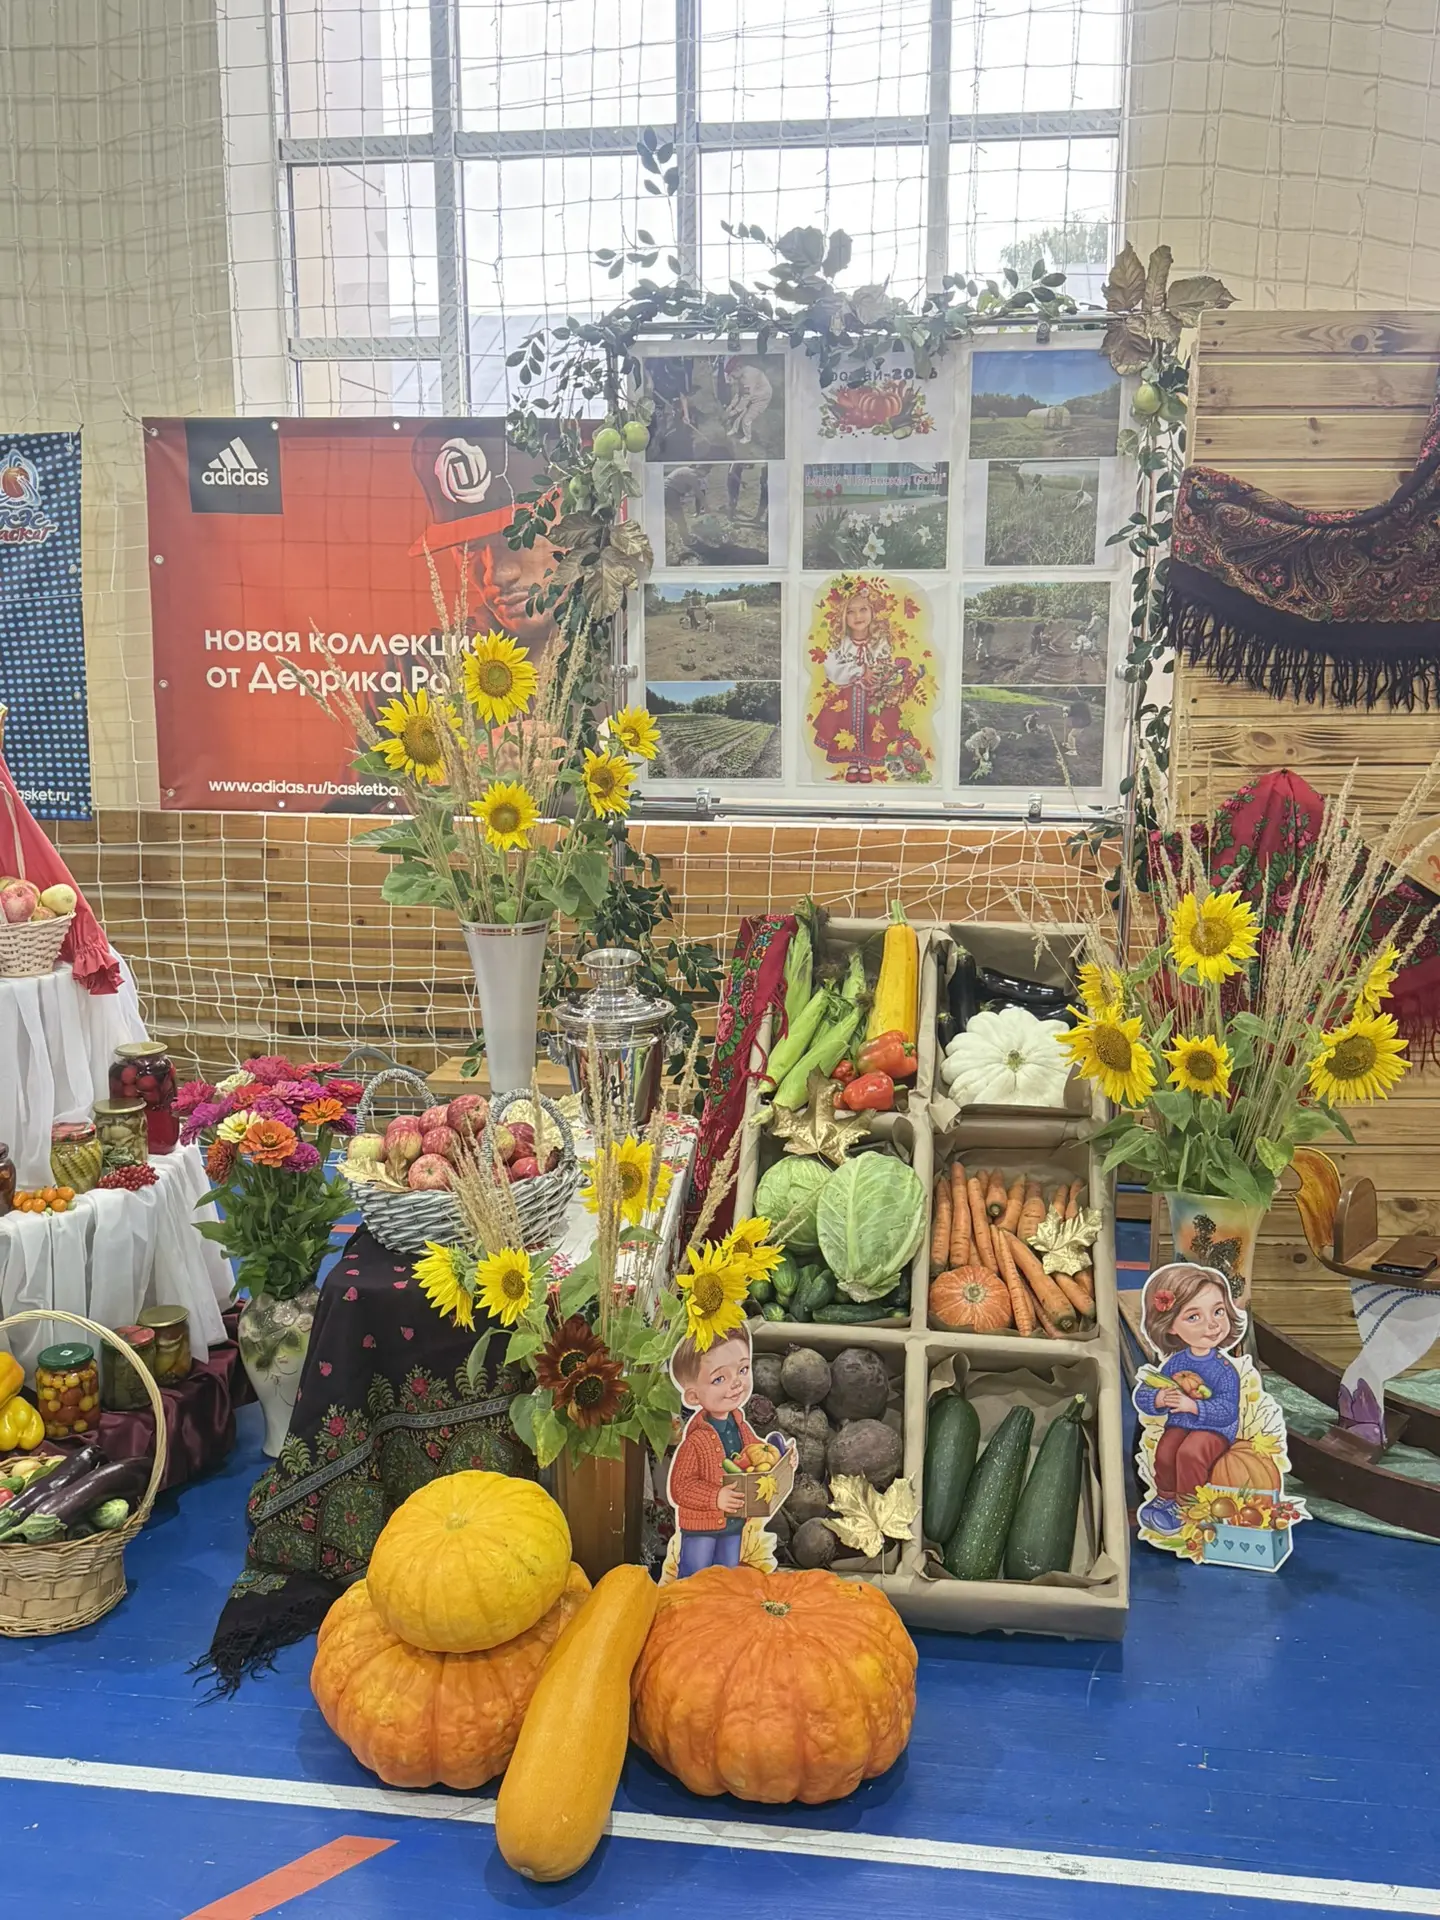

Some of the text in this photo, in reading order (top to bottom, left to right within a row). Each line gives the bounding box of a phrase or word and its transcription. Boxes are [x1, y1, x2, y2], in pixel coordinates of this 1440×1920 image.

[201, 467, 269, 486] adidas
[204, 629, 301, 653] новая
[206, 666, 241, 689] от
[248, 661, 401, 697] Деррика
[17, 787, 70, 802] asket.ru
[208, 779, 402, 797] www.adidas.ru/basketba
